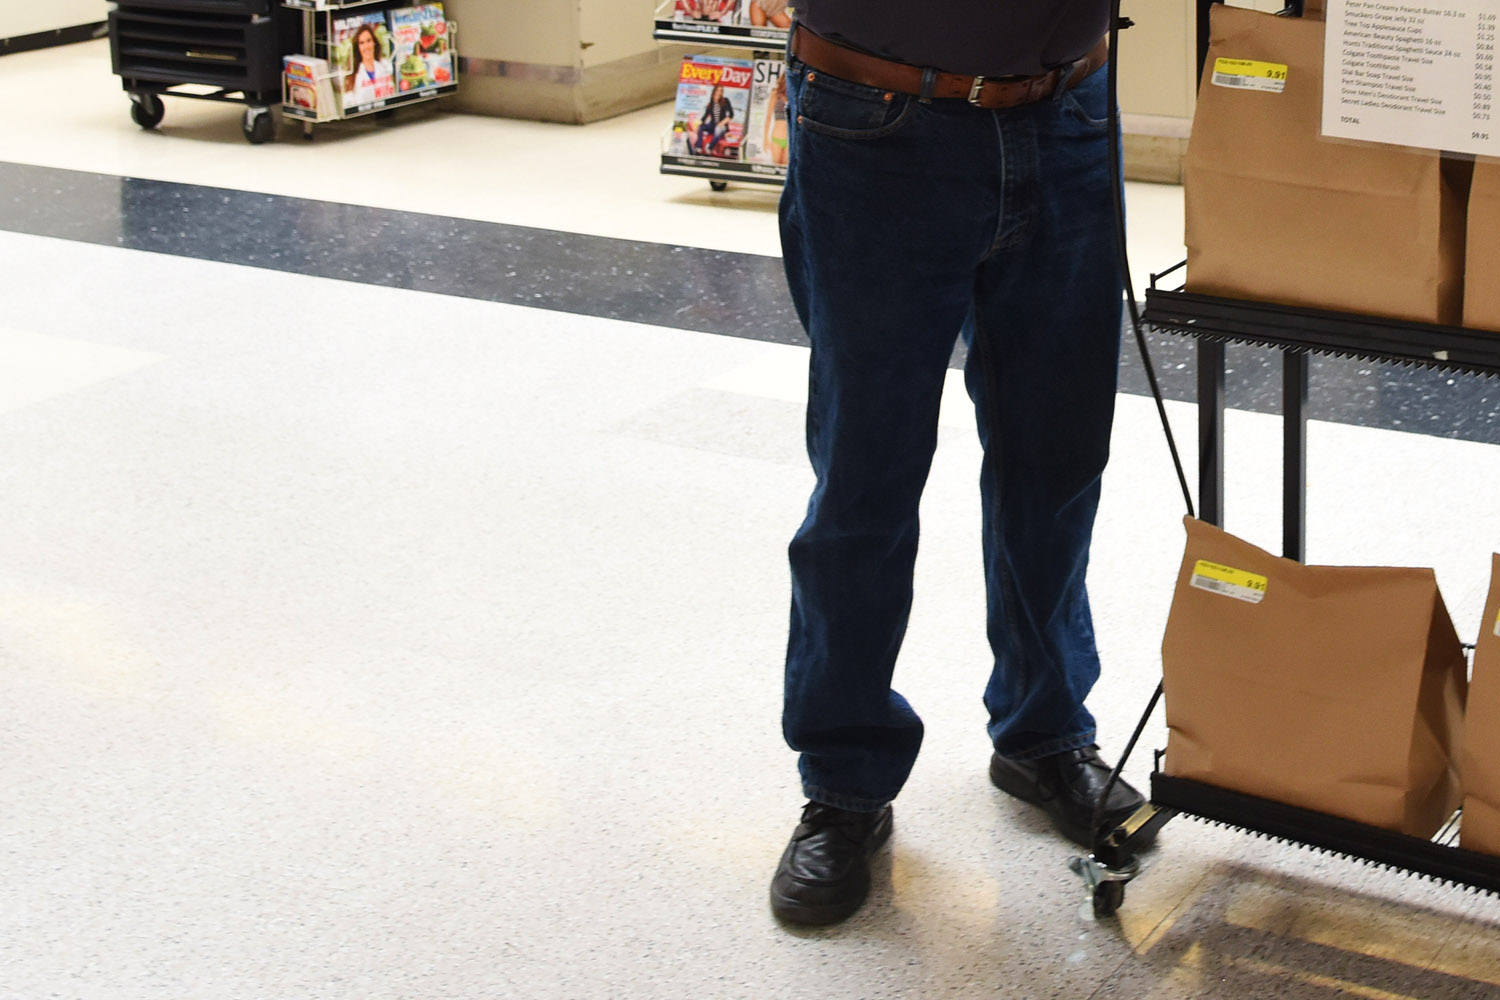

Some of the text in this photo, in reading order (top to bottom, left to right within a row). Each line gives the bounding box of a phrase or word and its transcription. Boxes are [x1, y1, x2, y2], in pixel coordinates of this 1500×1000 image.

[1266, 69, 1286, 79] 9.91
[1340, 116, 1360, 124] TOTAL
[1246, 579, 1266, 589] 9.91
